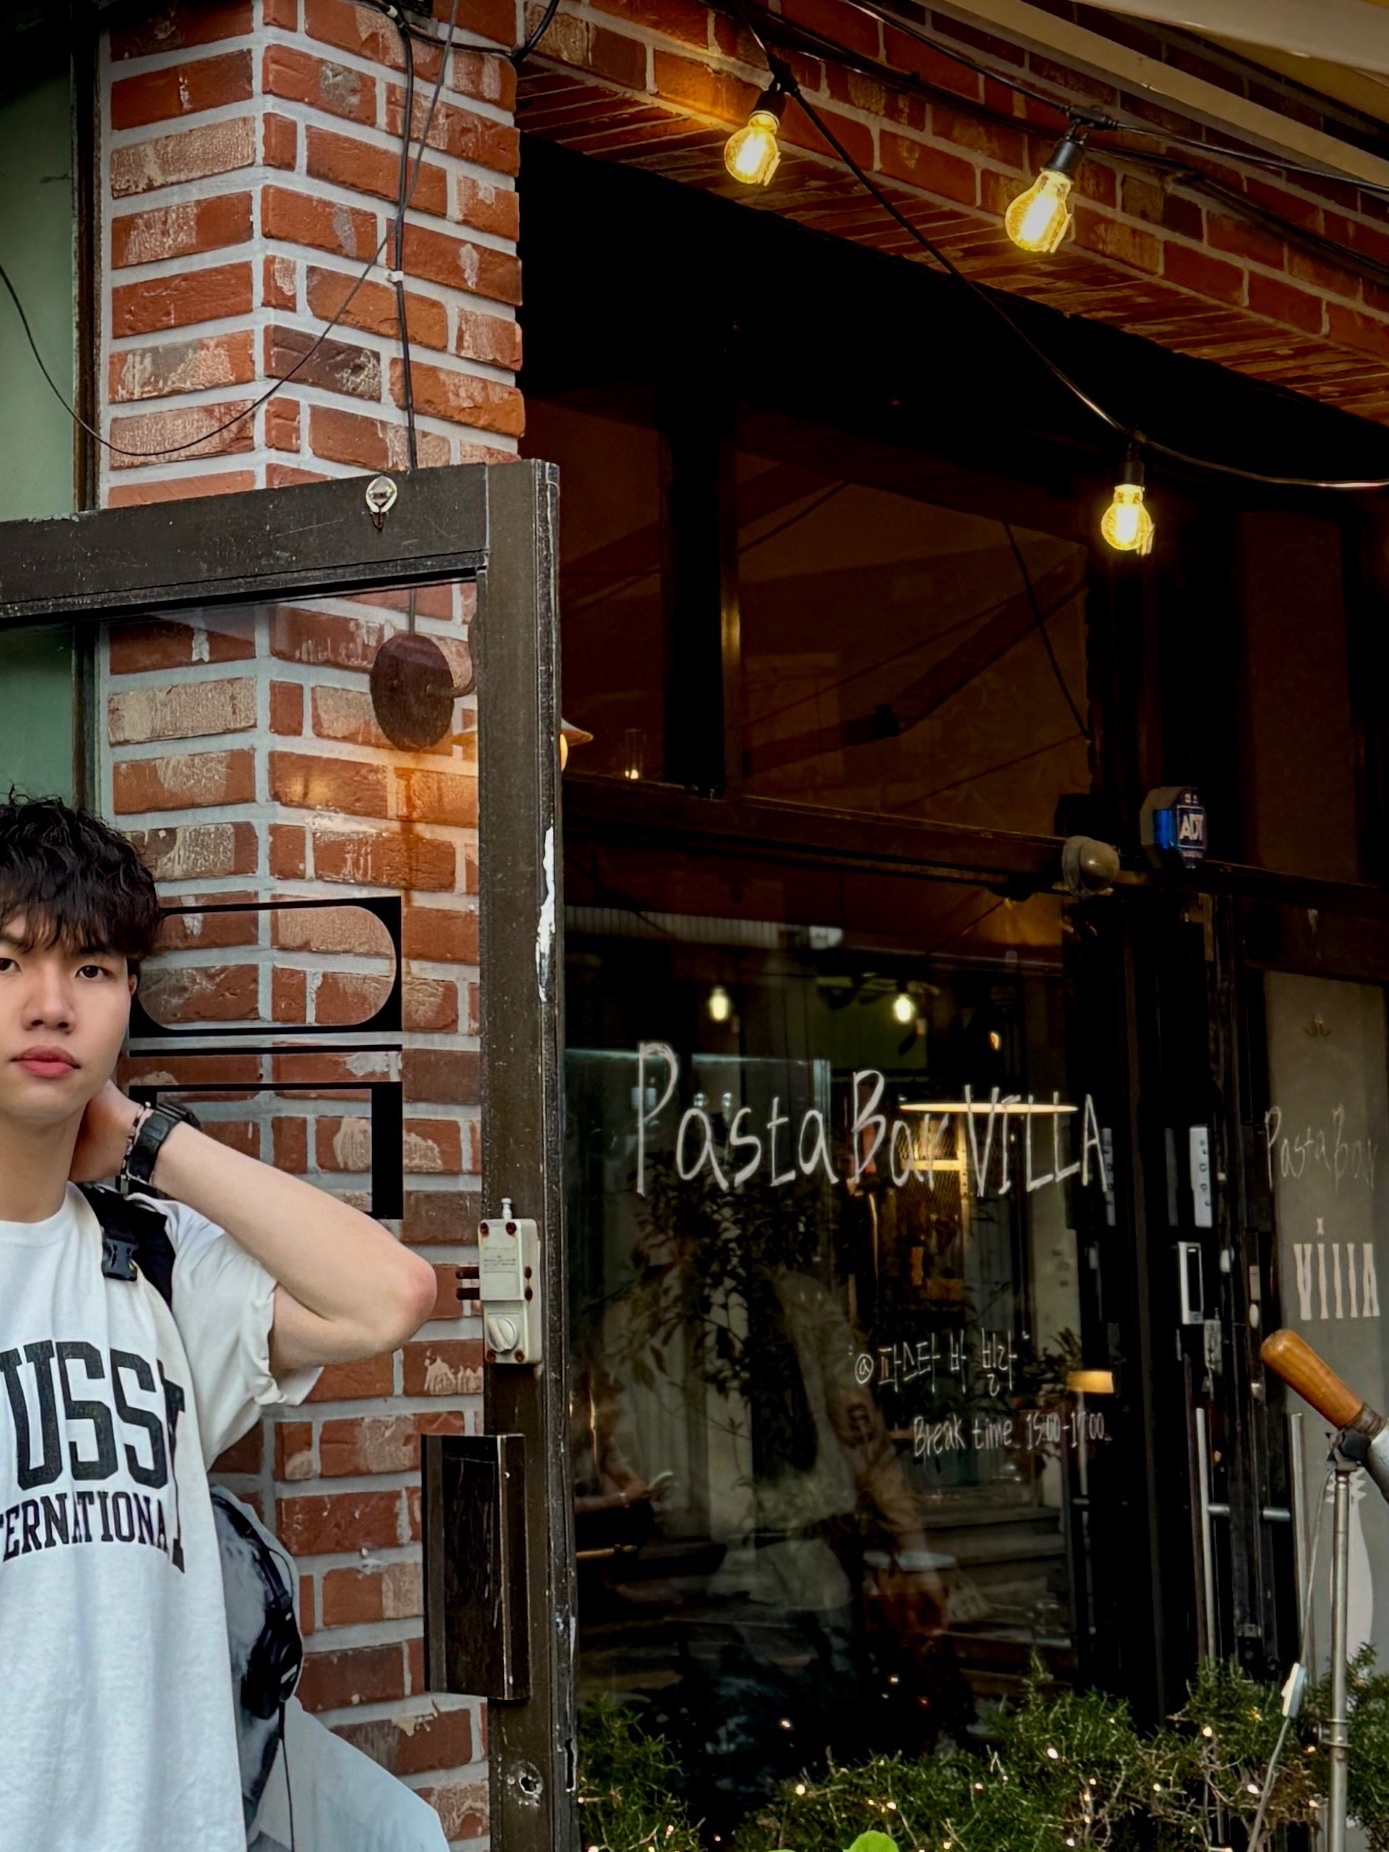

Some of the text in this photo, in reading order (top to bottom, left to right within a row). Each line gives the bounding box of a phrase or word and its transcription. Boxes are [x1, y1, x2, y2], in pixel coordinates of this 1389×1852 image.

[1179, 813, 1205, 841] ADT
[635, 1040, 839, 1198] Pasta
[849, 1069, 950, 1192] Bar
[913, 1412, 967, 1459] Break
[972, 1417, 1013, 1450] time
